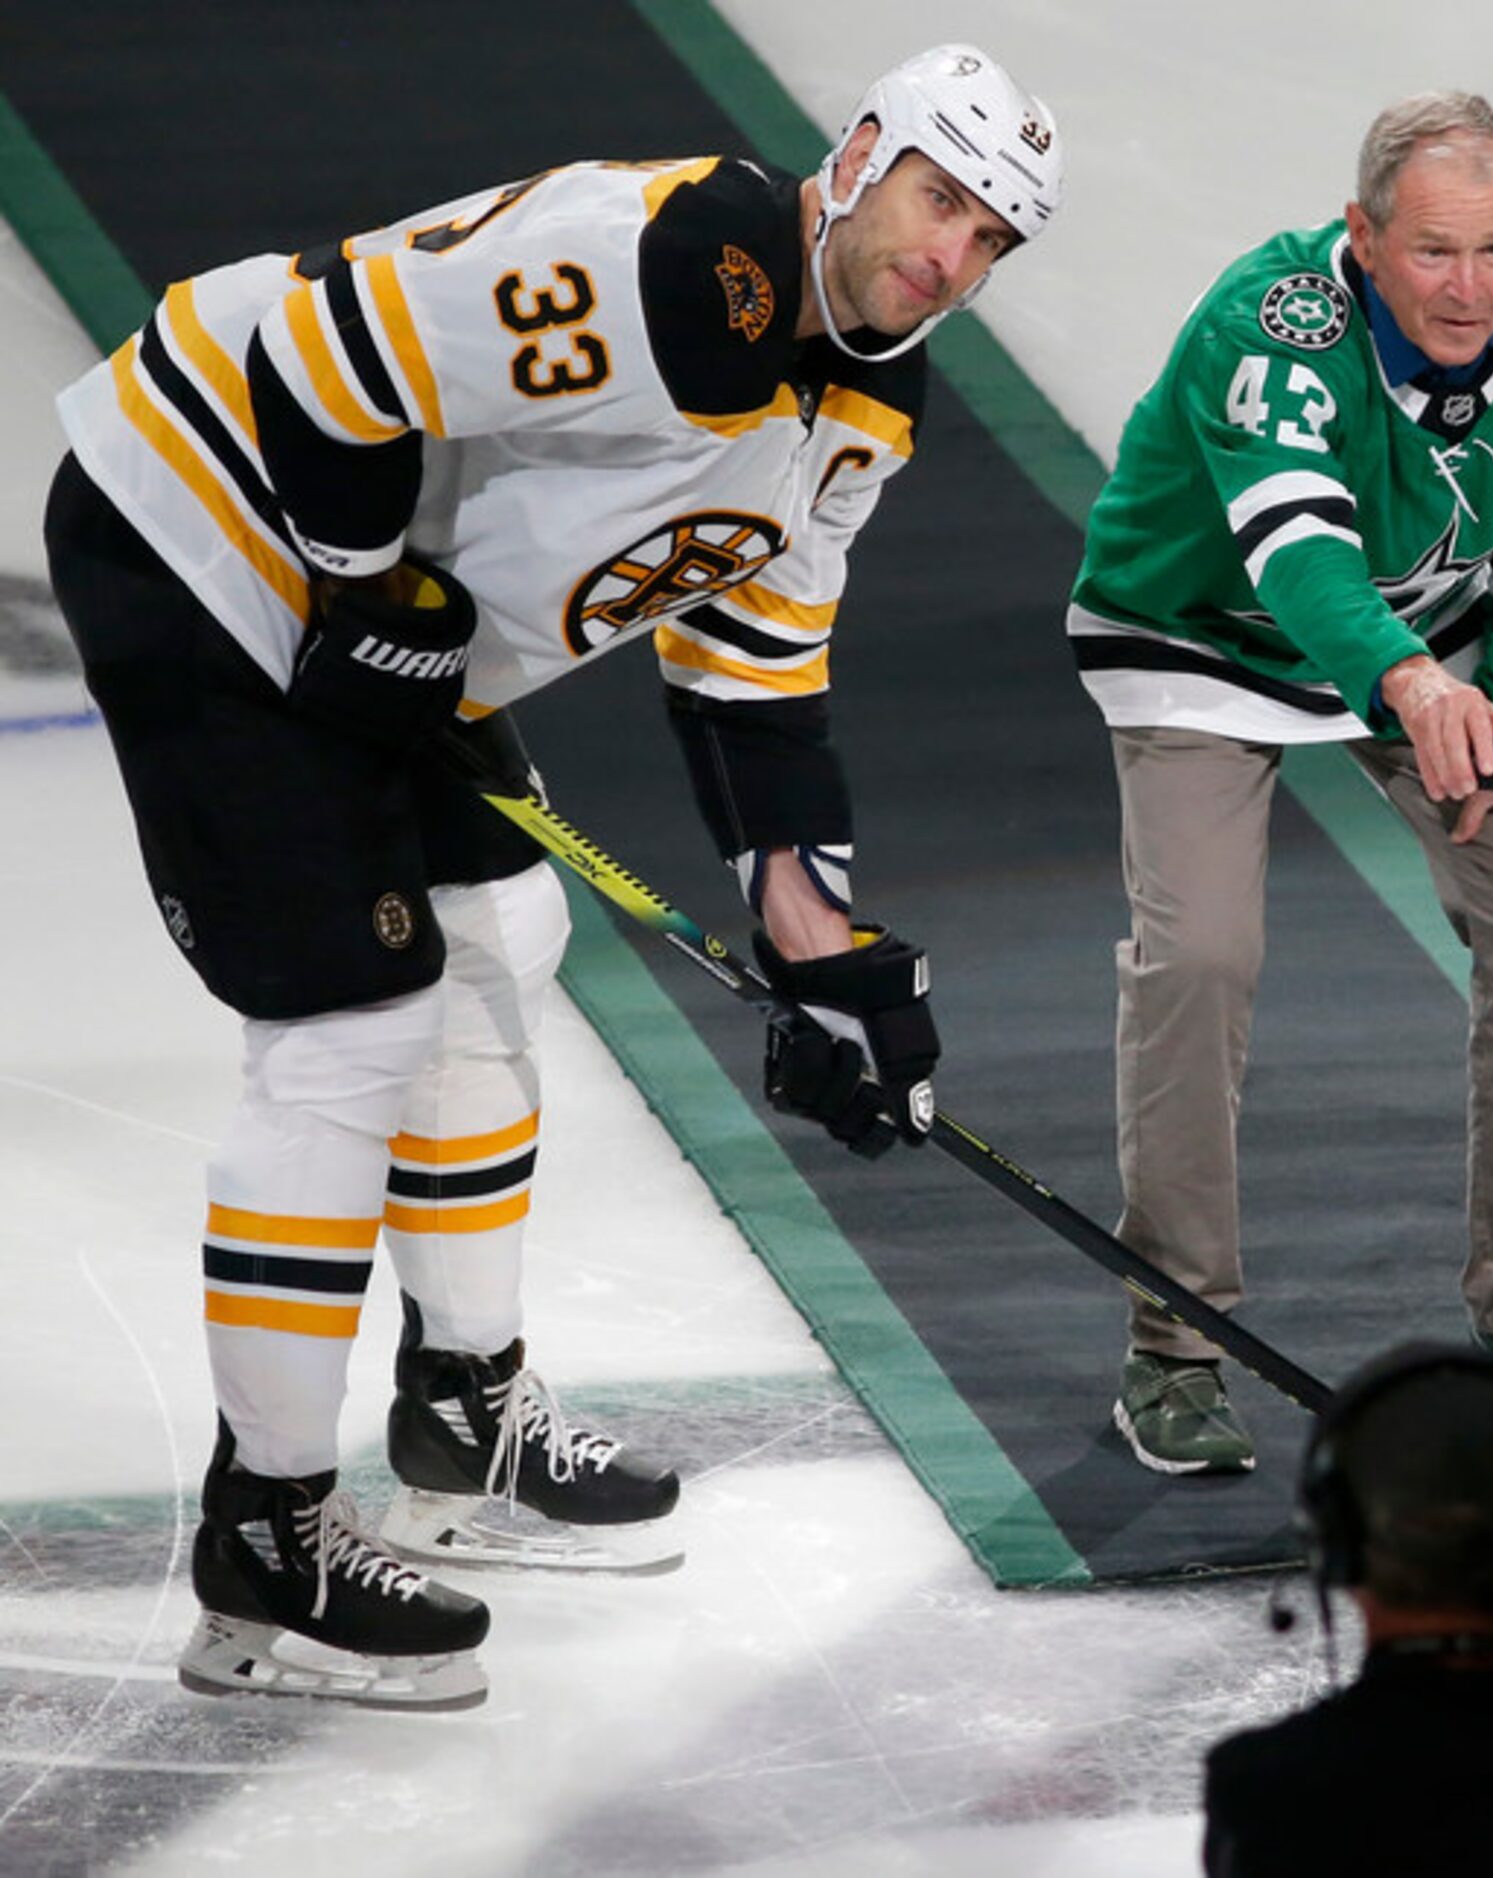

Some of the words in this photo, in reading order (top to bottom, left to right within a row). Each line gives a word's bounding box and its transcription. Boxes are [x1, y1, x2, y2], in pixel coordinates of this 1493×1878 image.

[1021, 121, 1052, 151] 33
[493, 261, 613, 401] 33
[1226, 355, 1337, 454] 43
